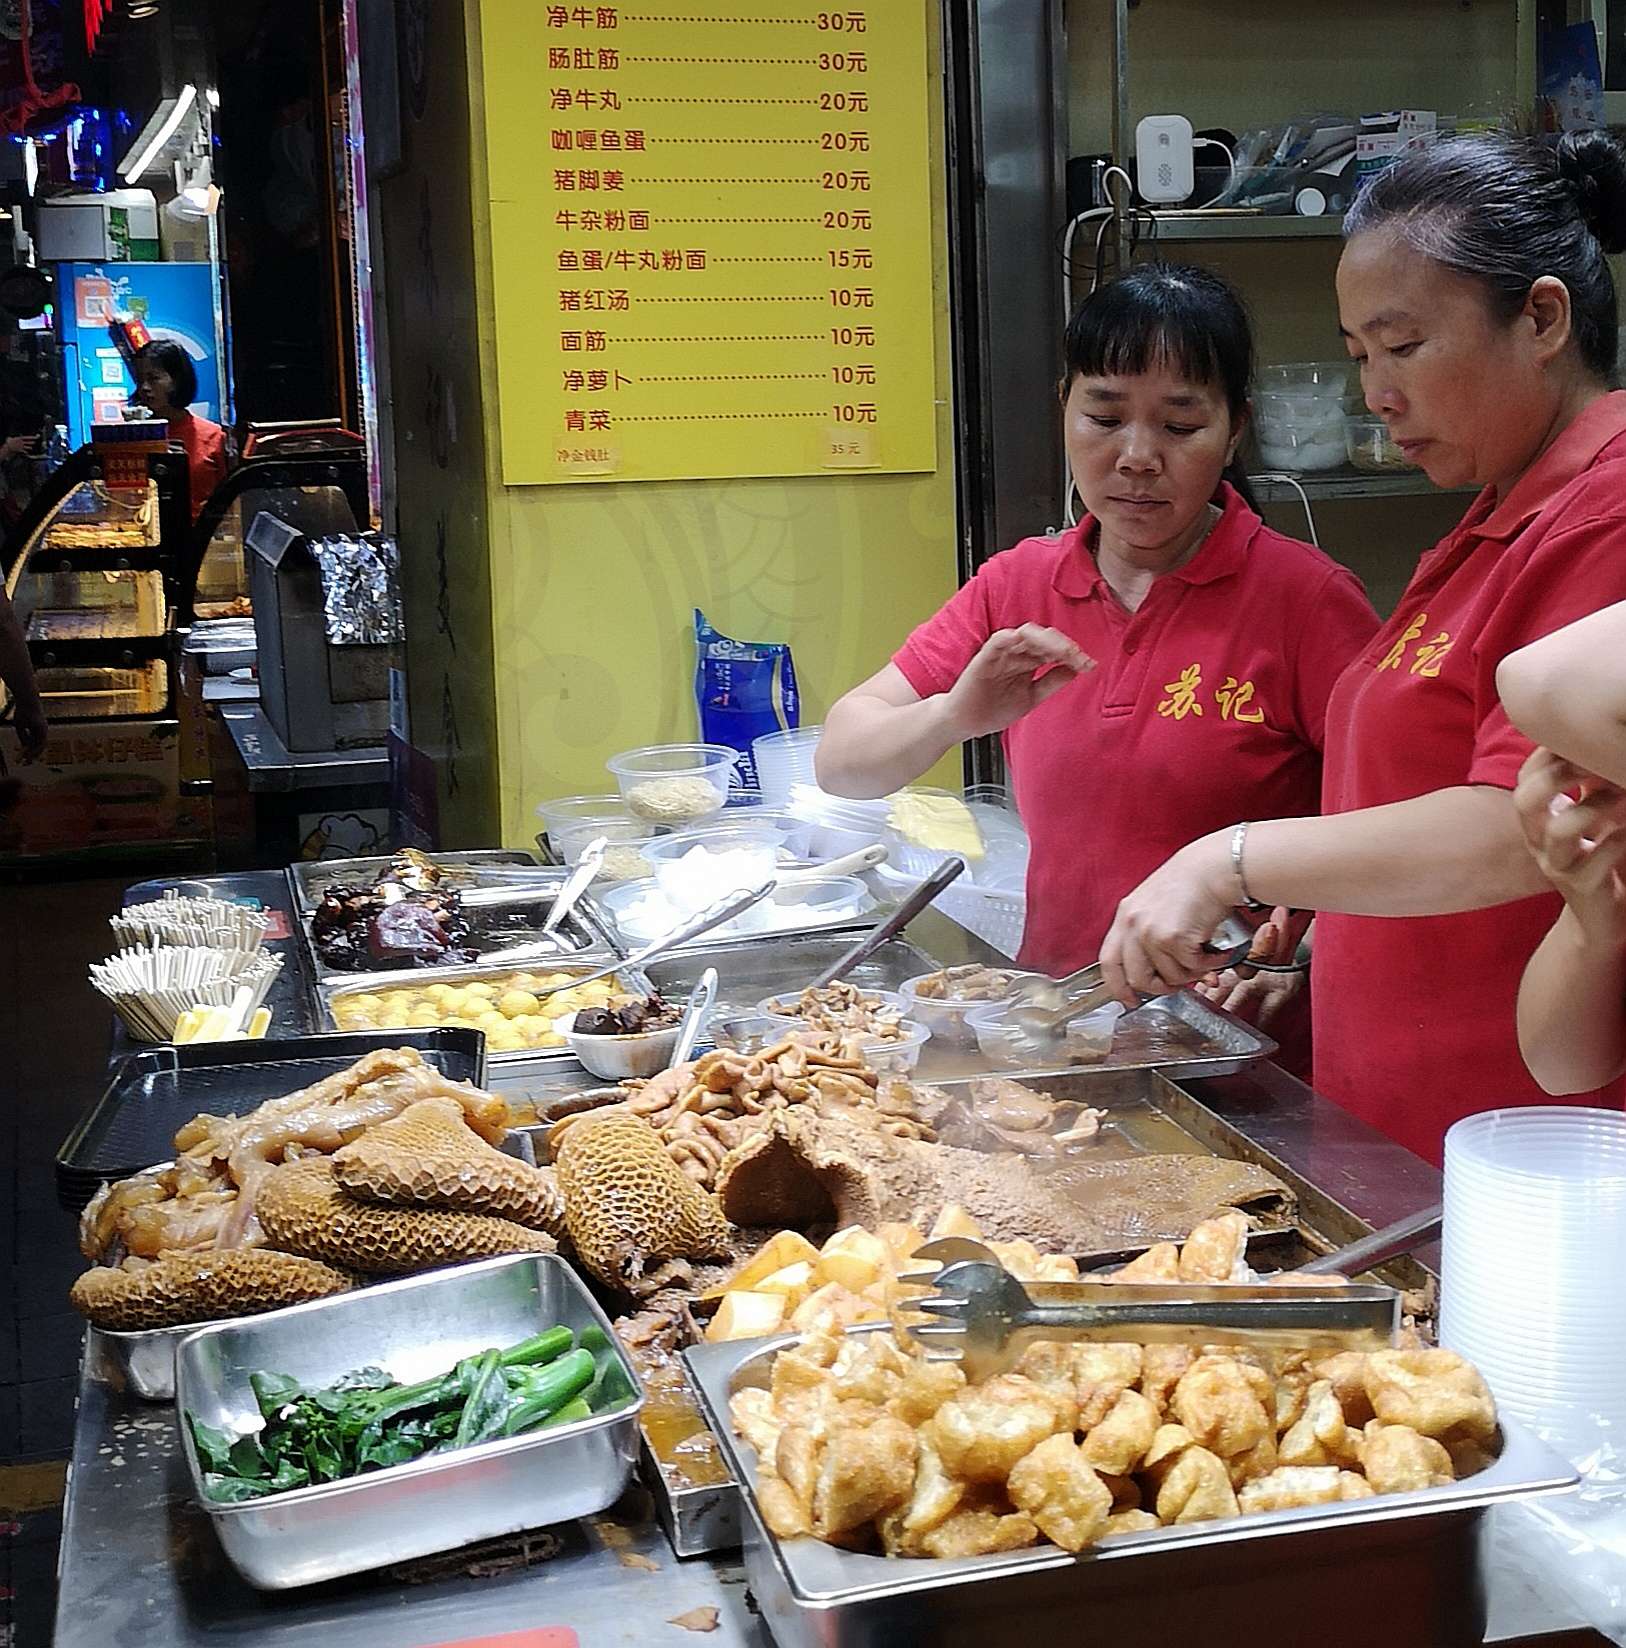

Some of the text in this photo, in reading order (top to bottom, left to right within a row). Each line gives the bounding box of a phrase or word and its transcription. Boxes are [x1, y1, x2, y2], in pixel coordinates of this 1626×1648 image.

[547, 6, 866, 32] 净牛筋 30元
[549, 48, 867, 73] 肠肚筋 30元
[551, 88, 868, 112] 净牛丸 20元
[551, 129, 869, 152] 咖喱鱼蛋 20元
[554, 169, 870, 191] 猪脚姜 20元
[556, 209, 871, 231] 牛杂粉面 20元
[558, 249, 872, 271] 鱼蛋/牛丸粉面 15元
[560, 288, 873, 311] 猪红汤 10元
[561, 327, 874, 352] 面筋 10元
[563, 365, 875, 392] 净萝卜 10元
[565, 404, 876, 431] 青菜 10元
[1157, 663, 1265, 723] 苏记
